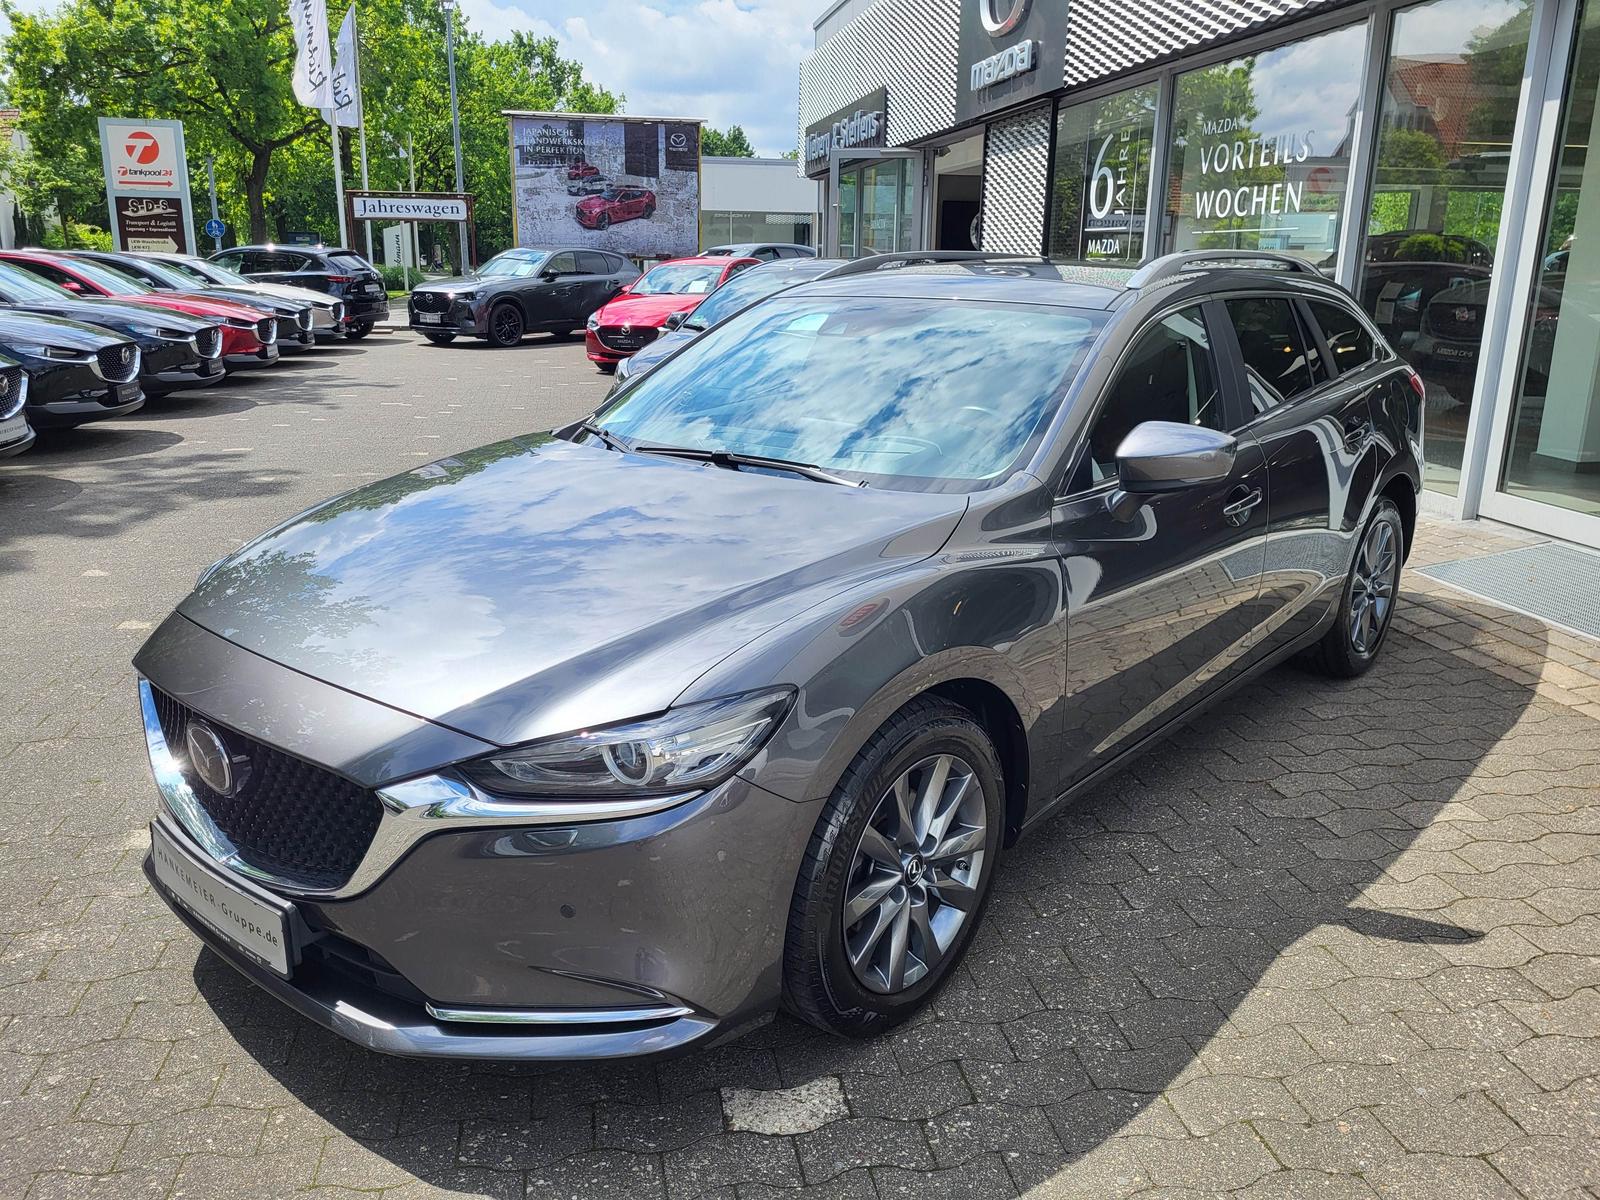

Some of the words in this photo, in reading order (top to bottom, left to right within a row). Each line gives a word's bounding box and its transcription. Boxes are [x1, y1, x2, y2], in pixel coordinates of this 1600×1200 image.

[523, 127, 574, 137] JAPANISCHE
[1202, 117, 1238, 136] MAZDA
[536, 146, 585, 155] PERFEKTION
[1200, 130, 1315, 175] VORTEILS
[1089, 133, 1114, 219] 6
[1114, 129, 1131, 217] JAHRE
[360, 199, 460, 217] Jahreswagen
[1195, 181, 1303, 220] WOCHEN
[1087, 239, 1120, 254] MAZDA
